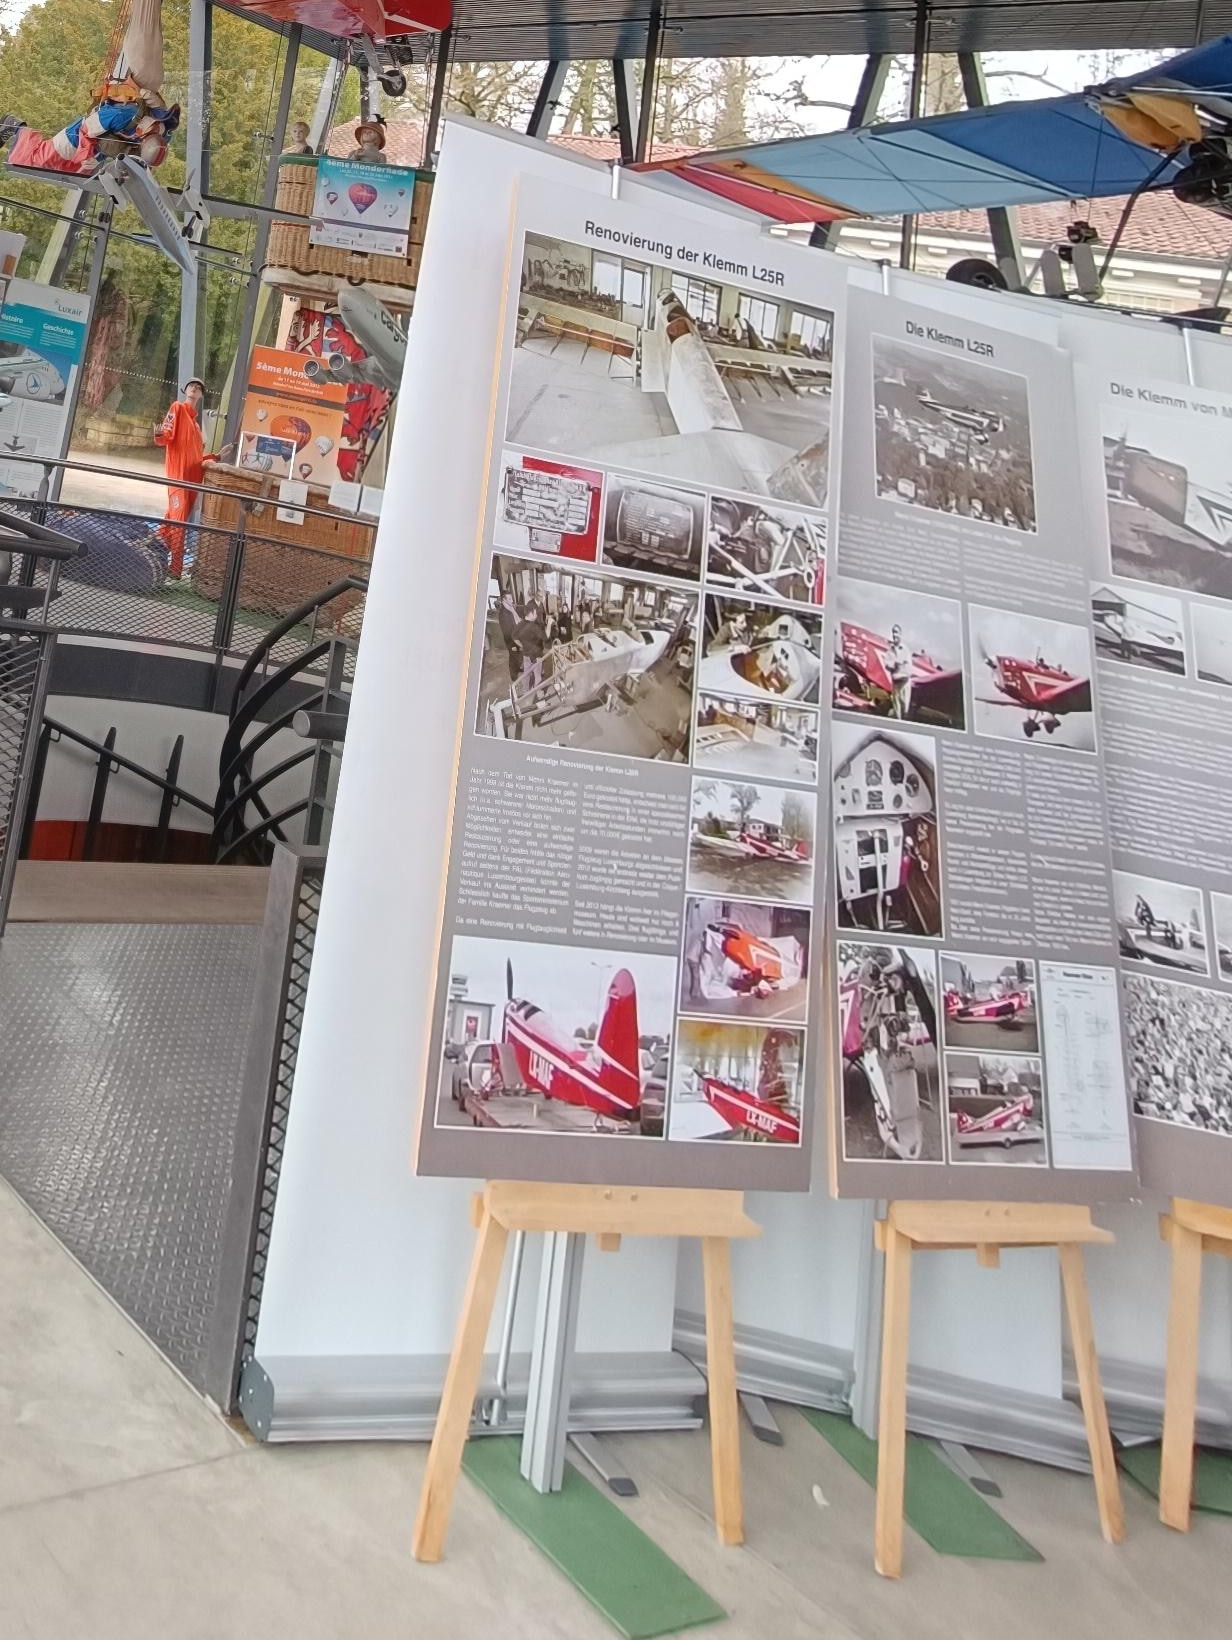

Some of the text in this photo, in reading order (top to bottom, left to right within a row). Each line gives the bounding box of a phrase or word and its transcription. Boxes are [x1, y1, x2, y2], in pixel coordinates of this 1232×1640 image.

[585, 221, 785, 286] Renovierung der Klemm L25R
[58, 305, 83, 316] Luxair
[906, 321, 994, 357] Die Klemm L25R
[256, 361, 282, 374] 5ème
[1110, 382, 1133, 398] Die
[1138, 388, 1187, 409] Klemm
[1191, 402, 1218, 416] von
